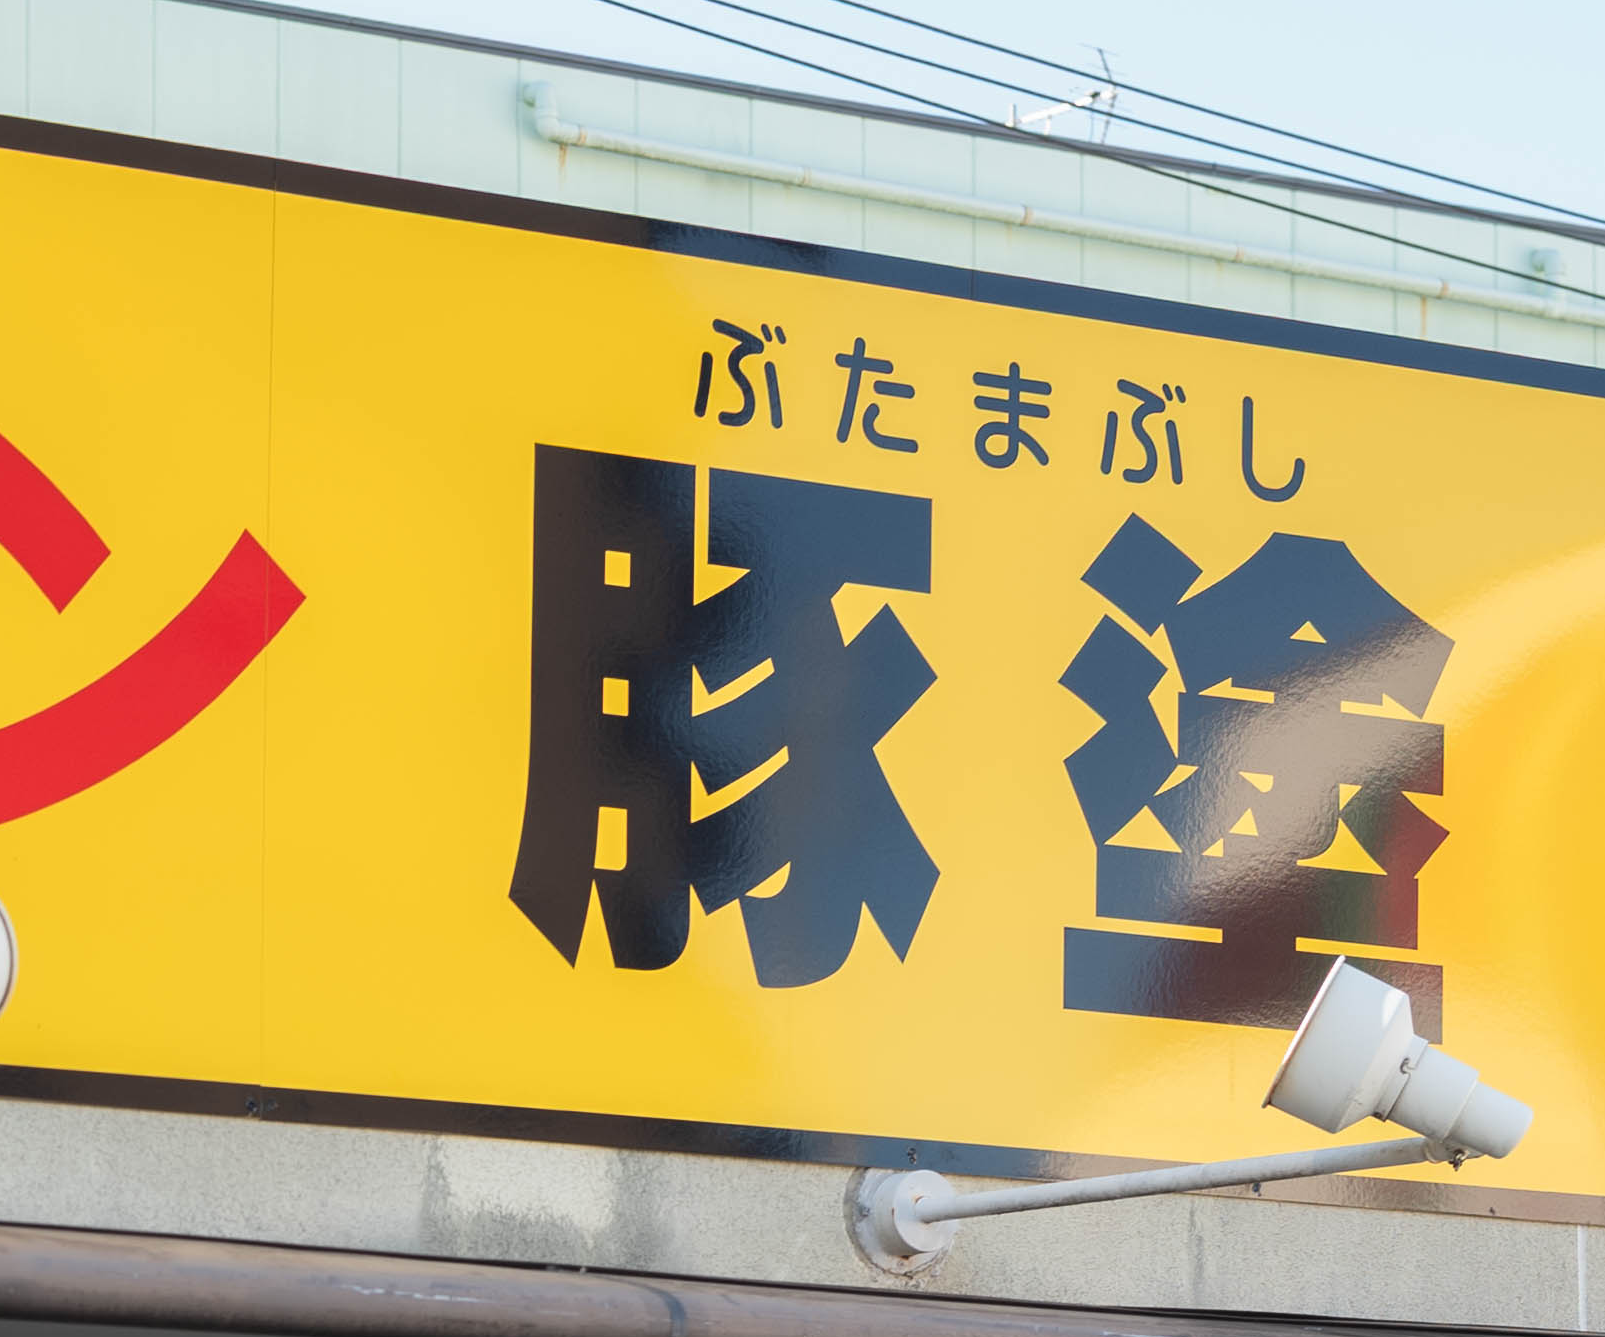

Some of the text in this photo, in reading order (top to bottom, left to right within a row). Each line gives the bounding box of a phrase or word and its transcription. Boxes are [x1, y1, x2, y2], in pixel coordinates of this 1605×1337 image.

[693, 319, 1306, 503] ぶたまぶし
[507, 442, 1456, 1046] 豚塗
